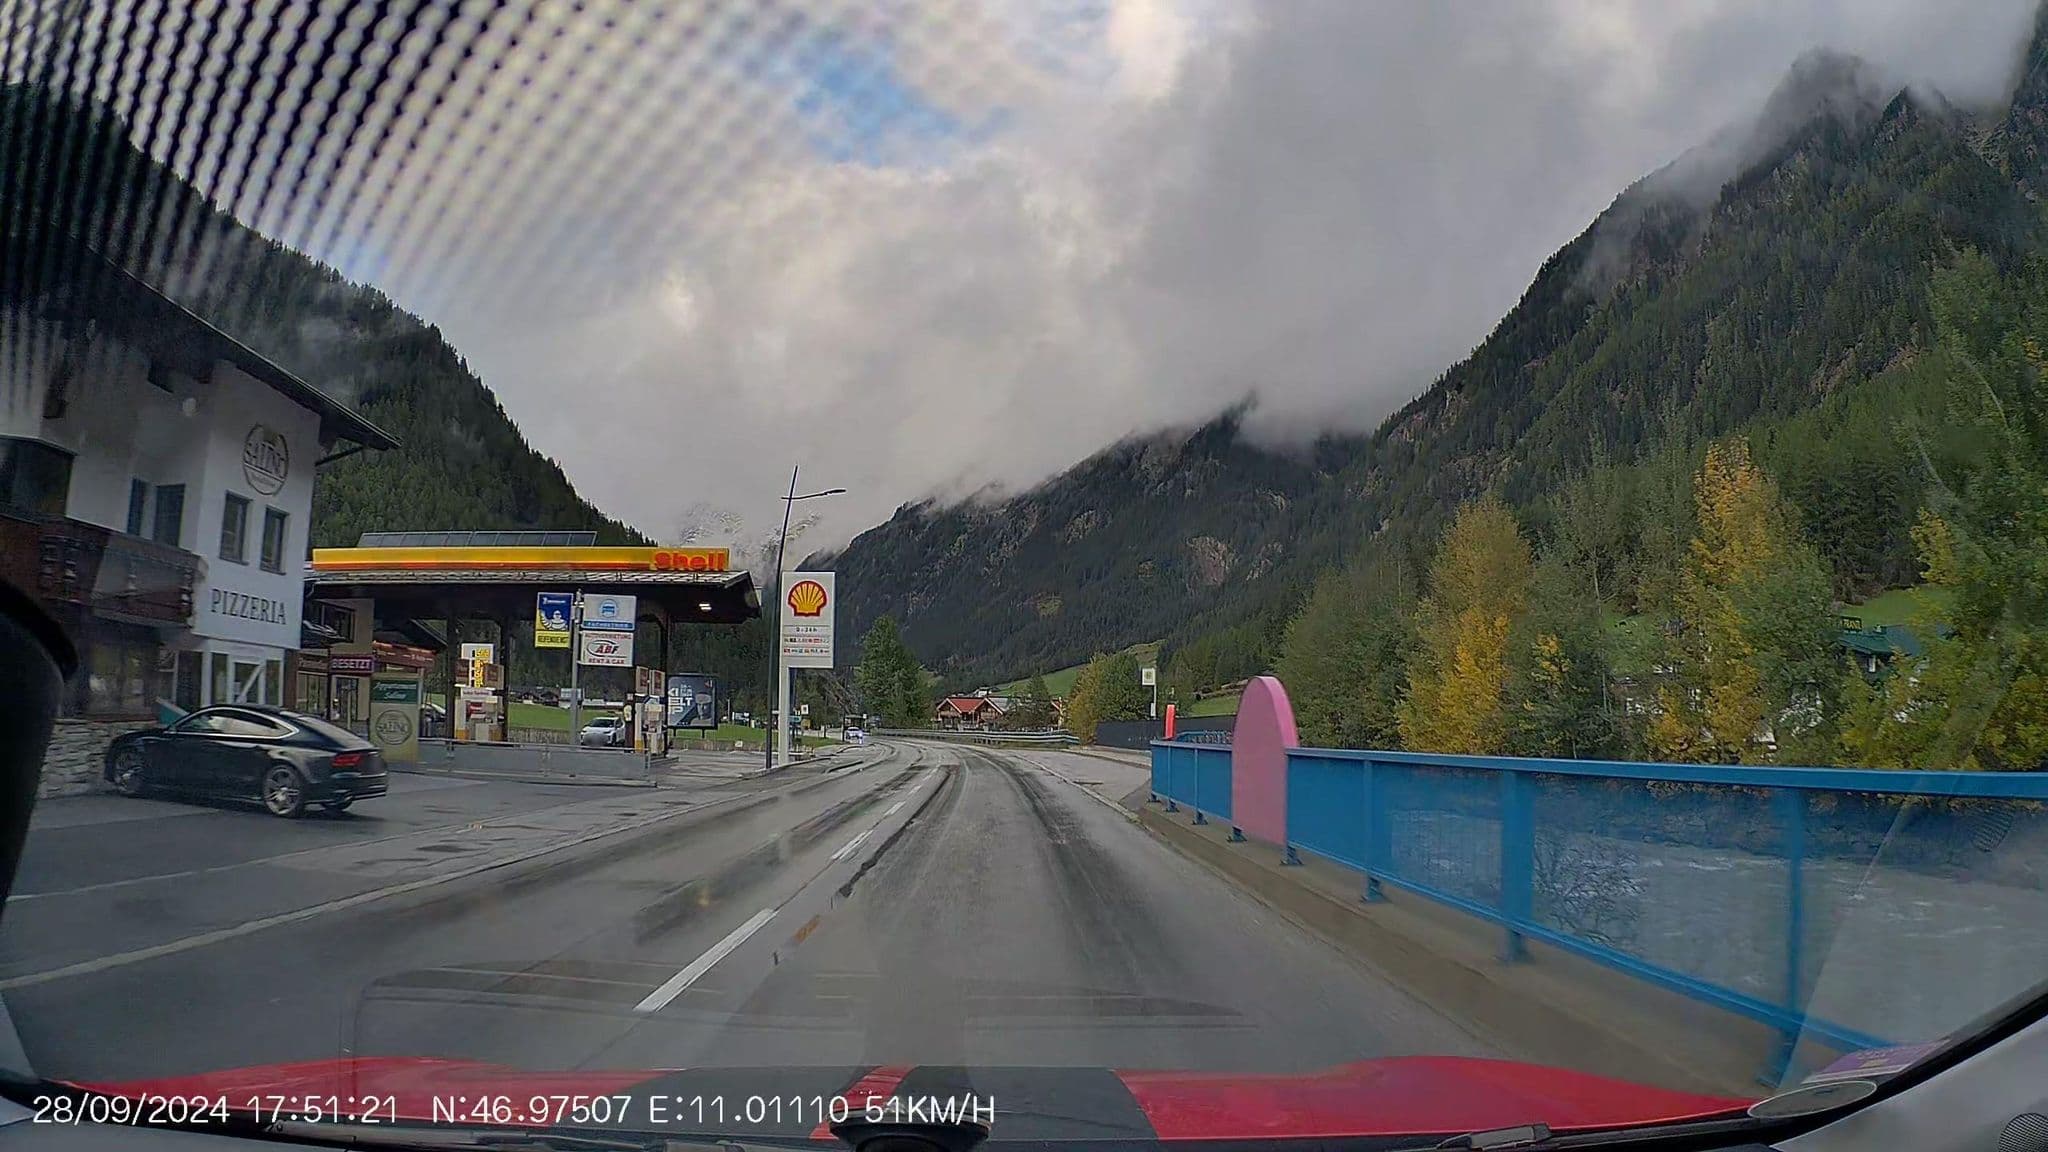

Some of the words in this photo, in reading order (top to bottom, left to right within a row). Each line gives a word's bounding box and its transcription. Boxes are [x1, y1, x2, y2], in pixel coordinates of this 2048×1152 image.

[654, 551, 725, 571] Shell
[211, 588, 286, 625] PIZZERIA
[595, 644, 619, 655] ABF
